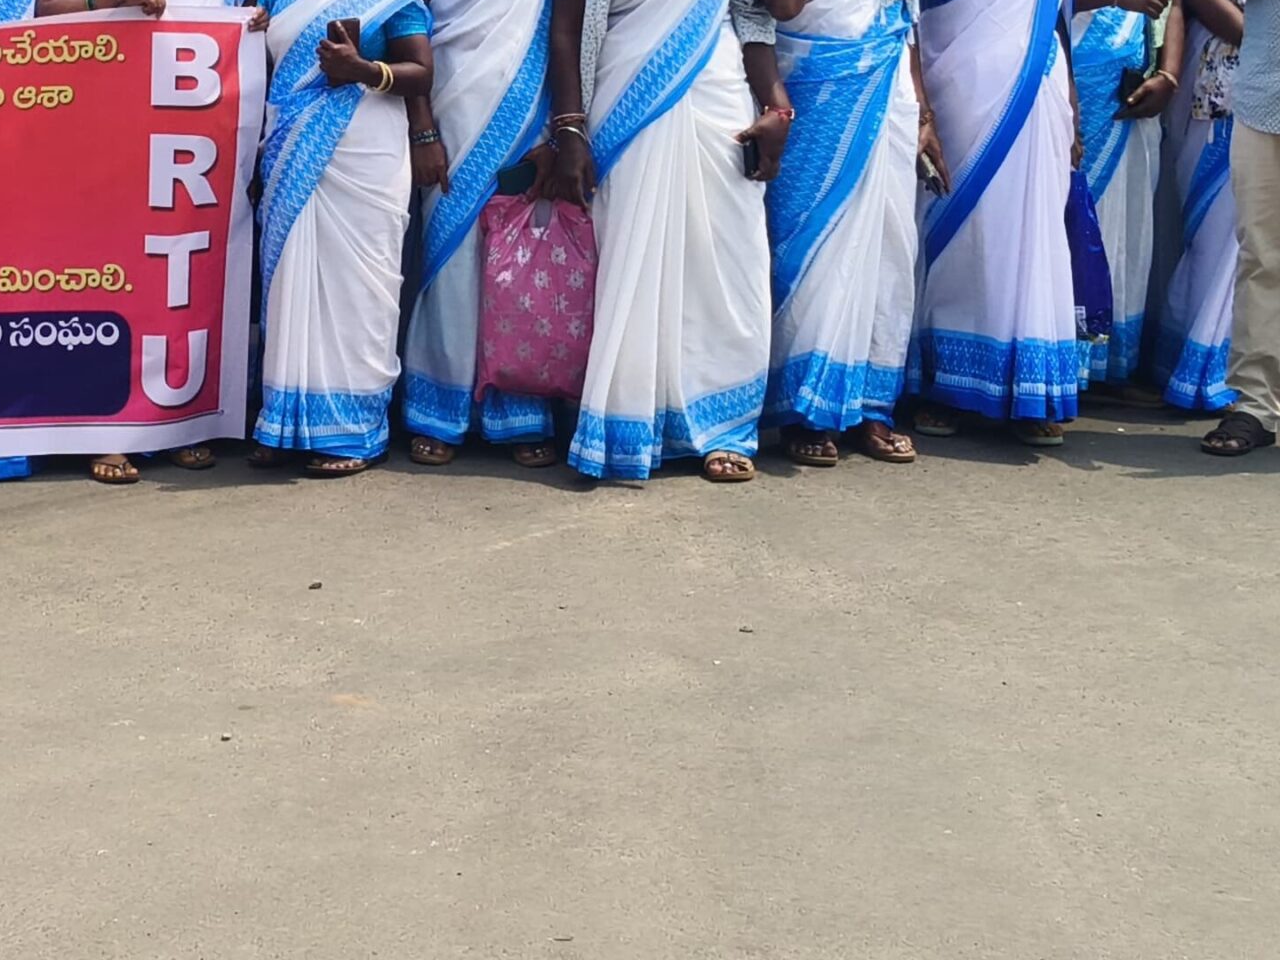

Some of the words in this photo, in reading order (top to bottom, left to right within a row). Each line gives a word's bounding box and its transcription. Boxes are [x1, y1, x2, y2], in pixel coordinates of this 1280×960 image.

[12, 82, 73, 109] ఆశా
[141, 31, 222, 408] BRTU
[9, 317, 120, 351] సంఘం
